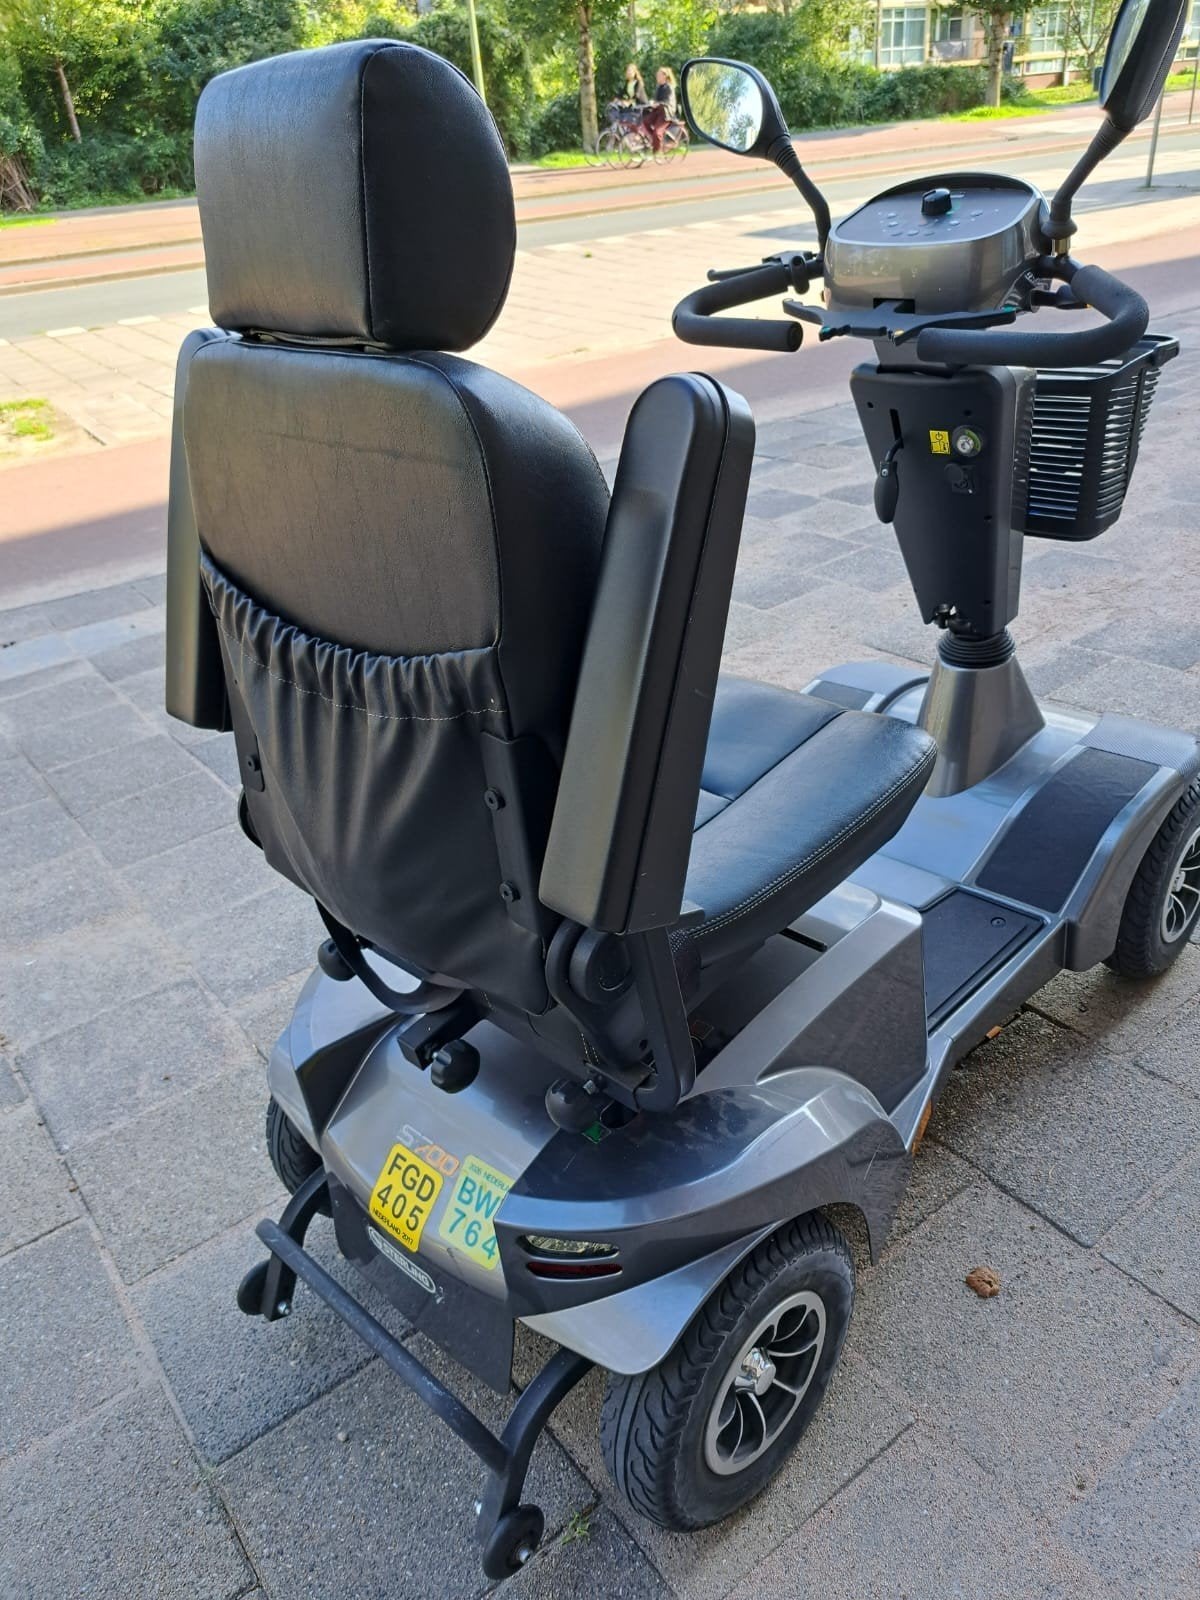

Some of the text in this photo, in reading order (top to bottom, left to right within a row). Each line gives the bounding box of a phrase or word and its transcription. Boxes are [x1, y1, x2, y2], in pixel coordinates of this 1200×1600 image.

[388, 1152, 435, 1202] FGD
[373, 1207, 401, 1235] NEDERLAND
[377, 1184, 424, 1231] 405
[448, 1208, 498, 1260] 764
[382, 1242, 430, 1287] STERLING
